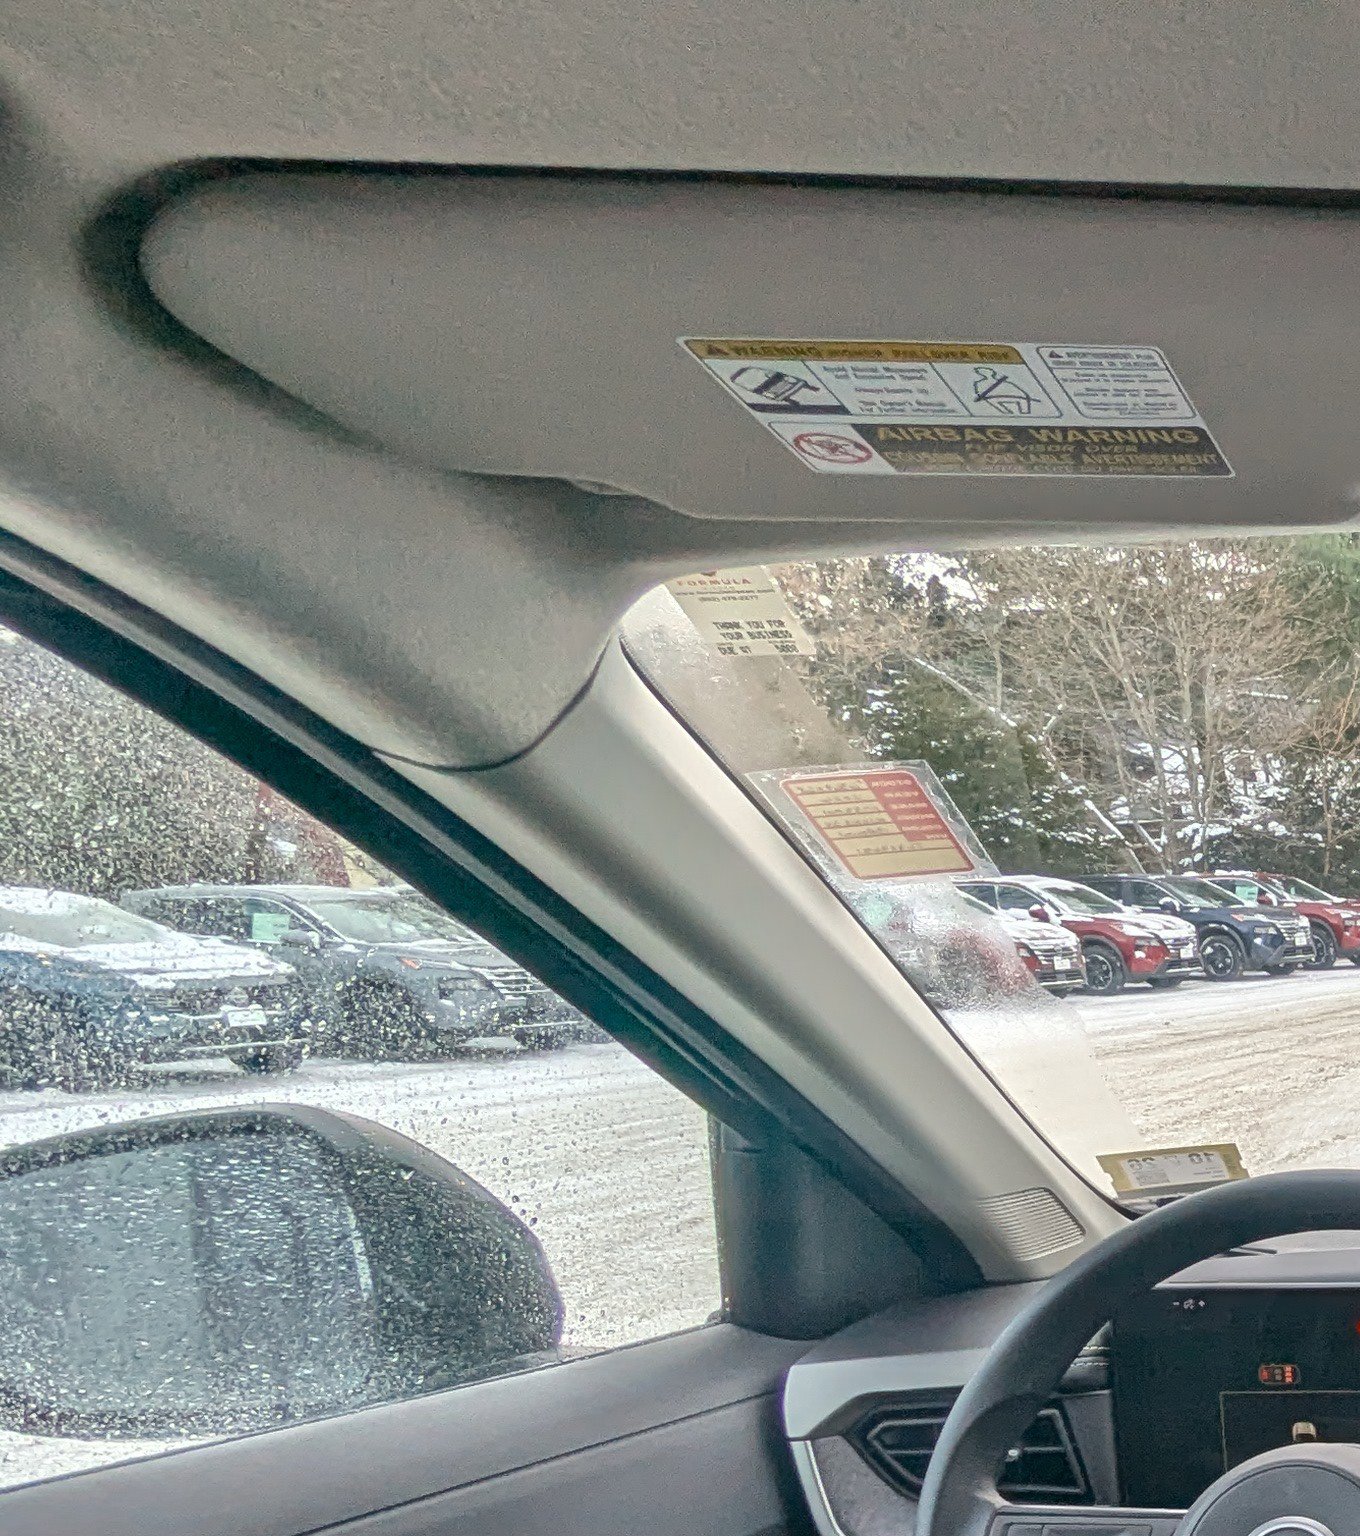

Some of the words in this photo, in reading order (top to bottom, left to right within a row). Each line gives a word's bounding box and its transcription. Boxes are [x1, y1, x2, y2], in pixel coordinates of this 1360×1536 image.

[878, 427, 1015, 442] AIRBAG
[1029, 428, 1199, 444] WARNING
[676, 578, 752, 587] FORMULA
[712, 620, 741, 631] THANK
[746, 620, 765, 630] YOU
[766, 619, 786, 629] FOR
[720, 631, 744, 641] YOUR
[746, 630, 793, 640] BUSINESS
